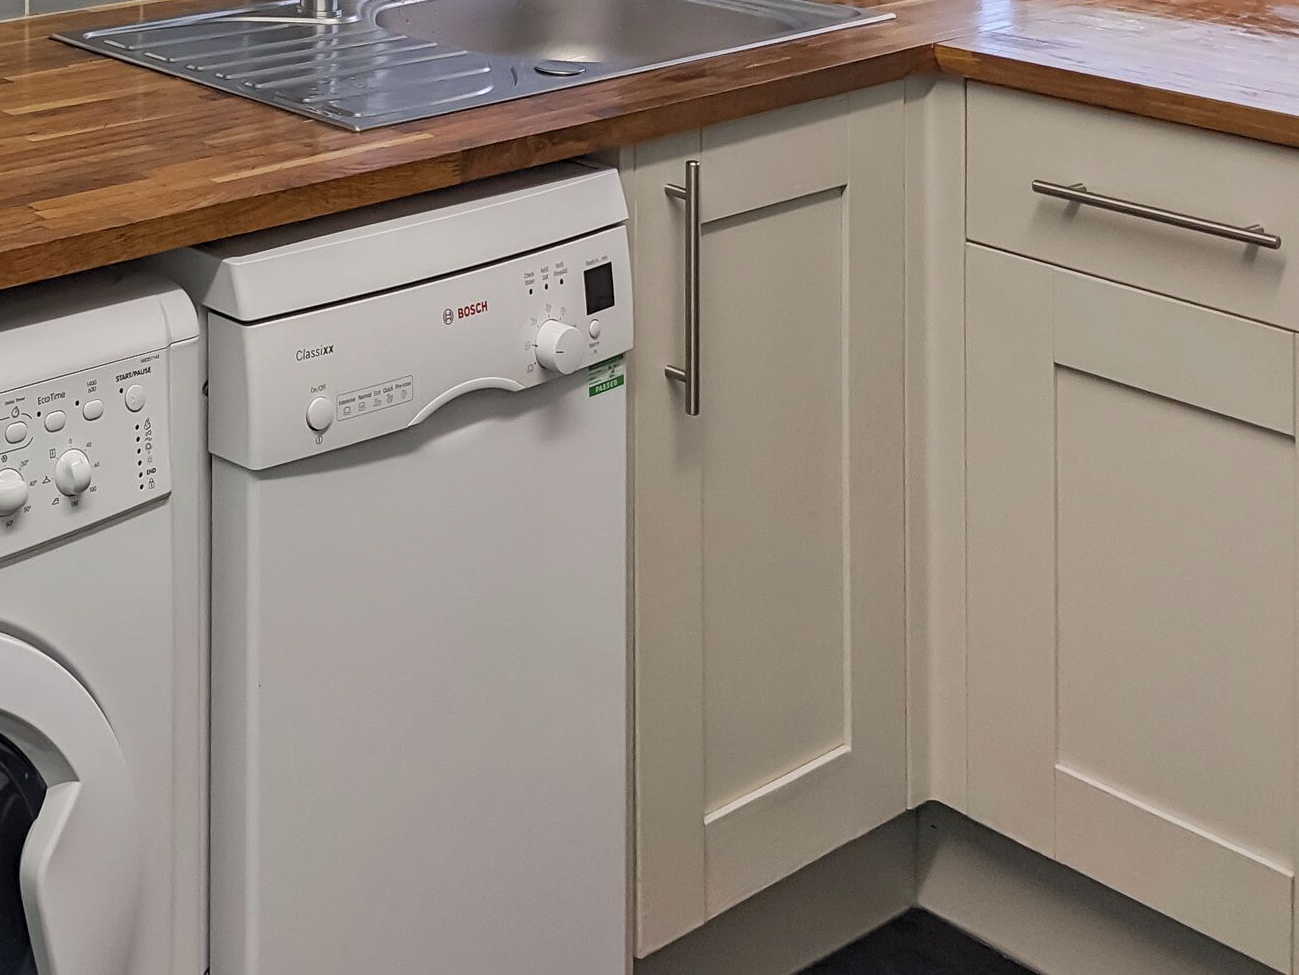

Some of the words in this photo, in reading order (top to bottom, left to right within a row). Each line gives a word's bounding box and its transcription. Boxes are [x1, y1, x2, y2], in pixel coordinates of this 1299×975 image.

[458, 301, 488, 319] BOSCH
[296, 343, 334, 361] Classixx
[115, 367, 151, 382] START/PAUSE
[595, 380, 618, 393] PASSED
[37, 391, 66, 405] EcoTime
